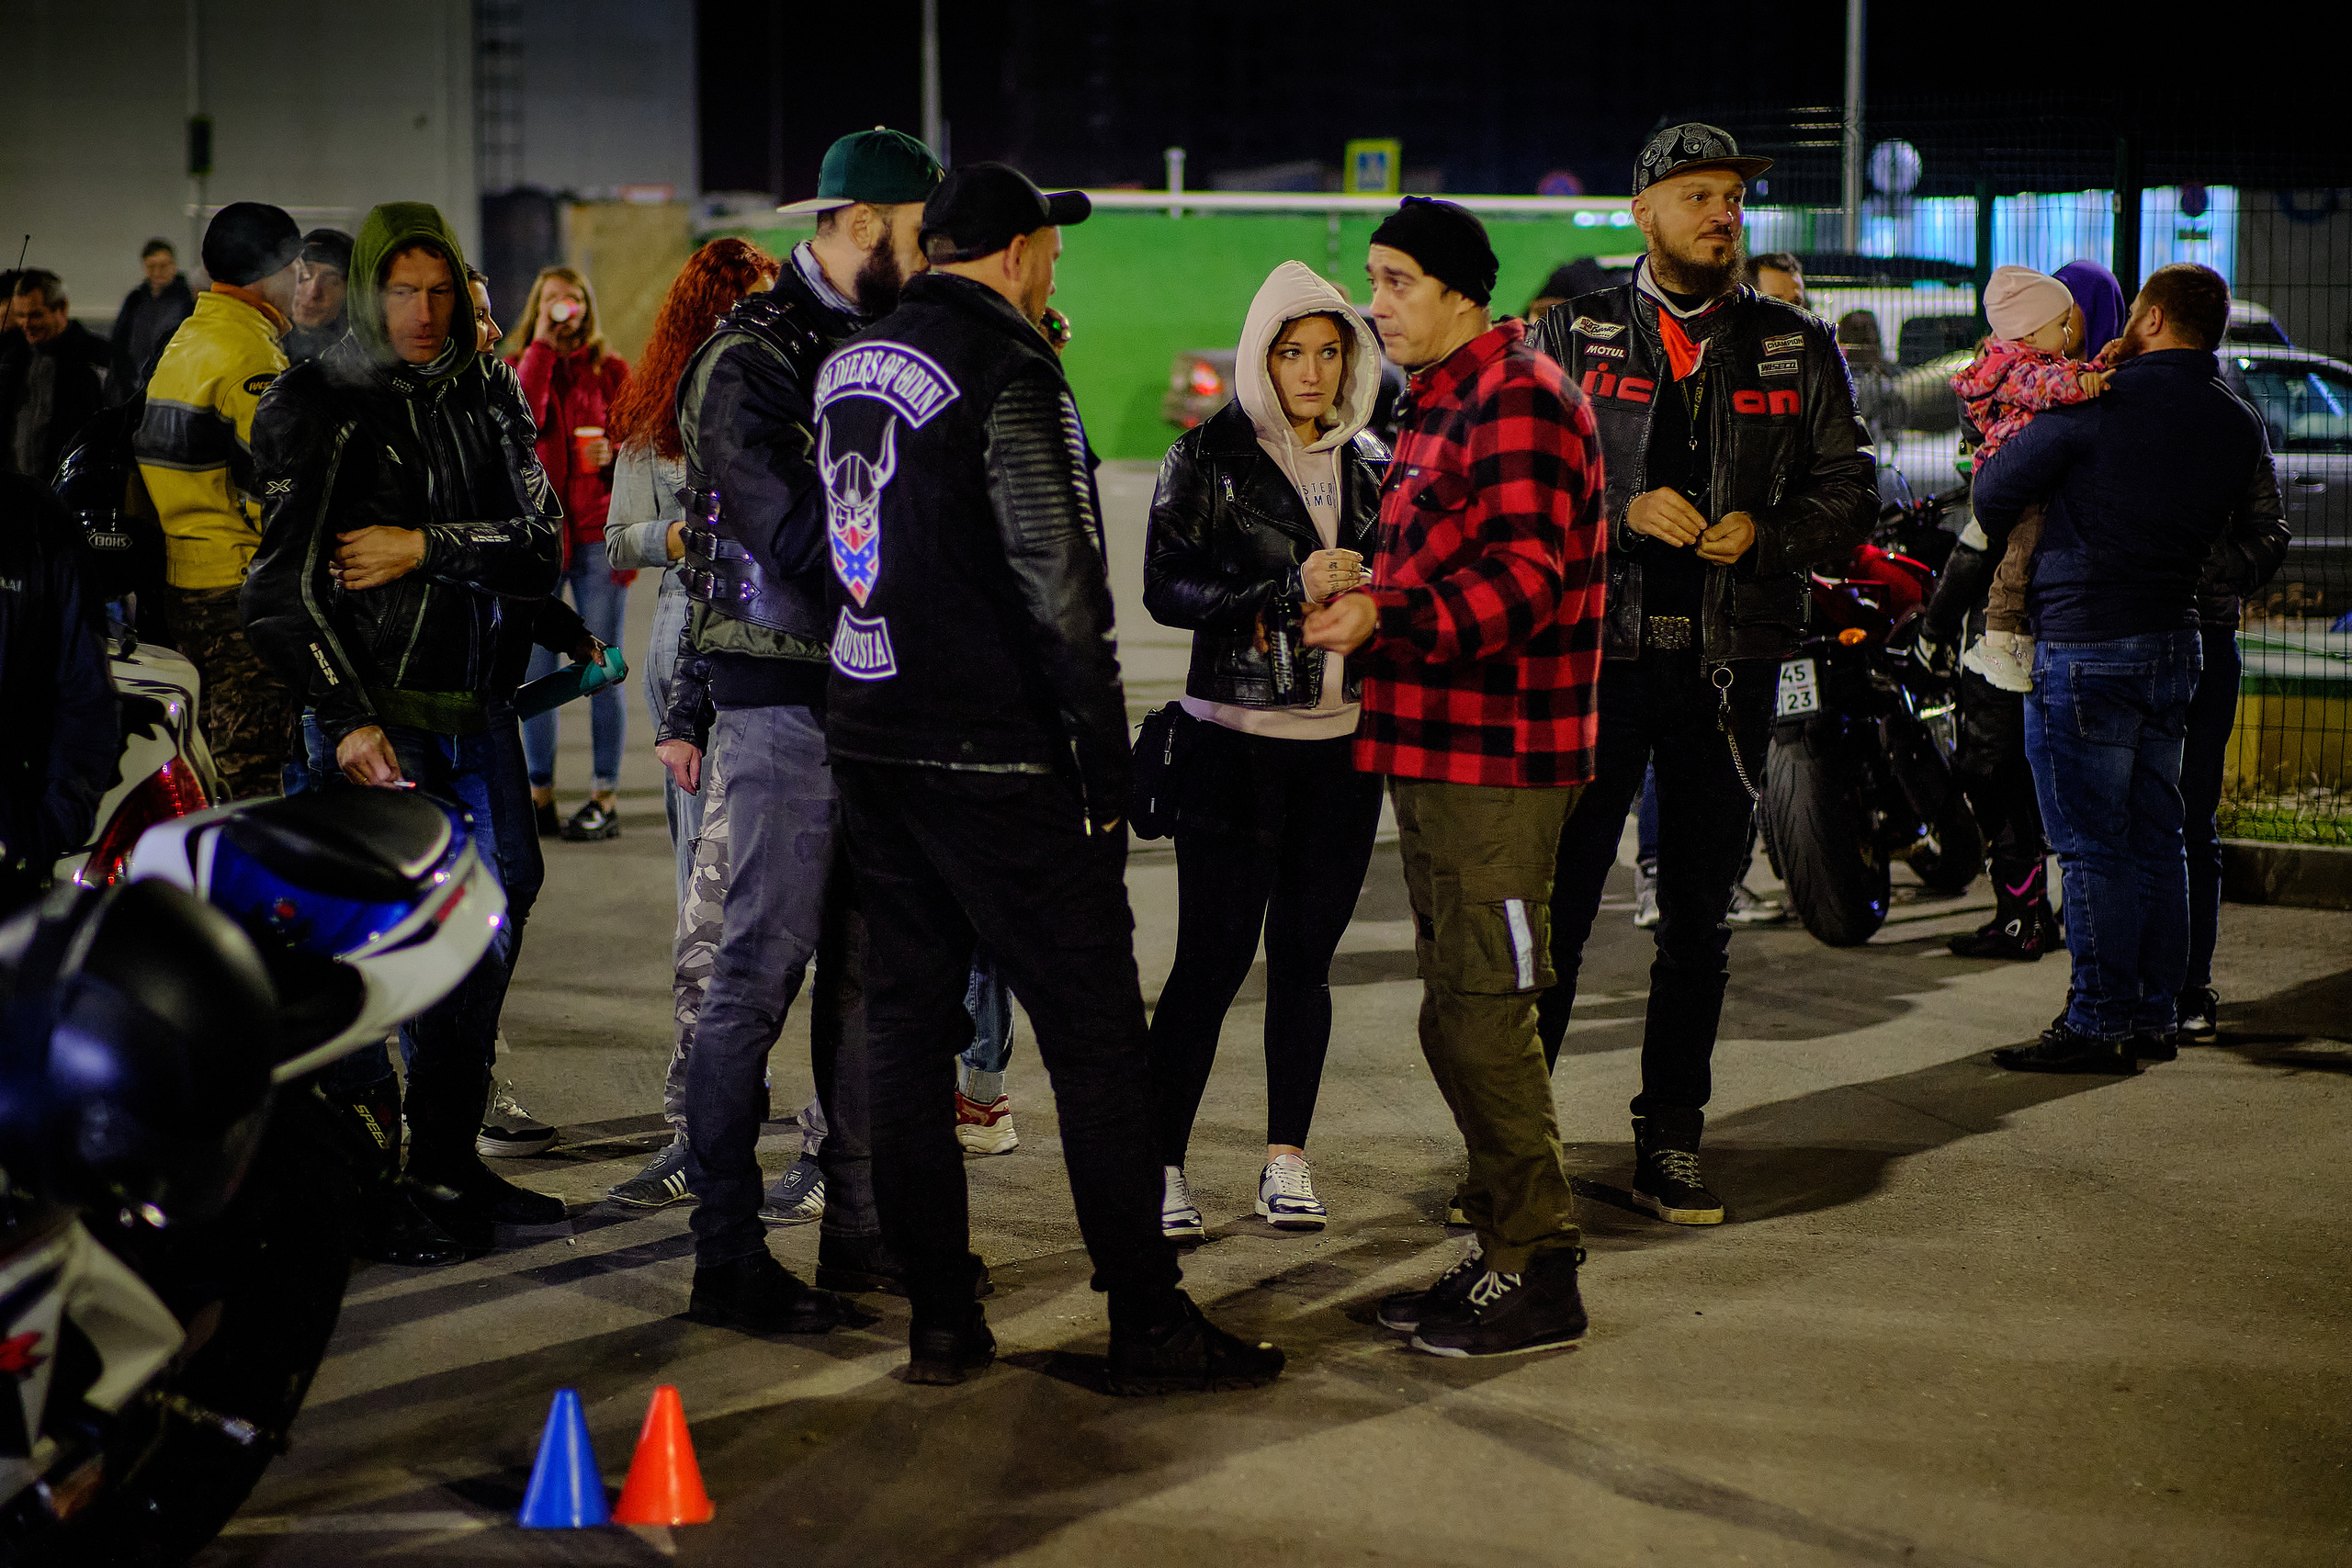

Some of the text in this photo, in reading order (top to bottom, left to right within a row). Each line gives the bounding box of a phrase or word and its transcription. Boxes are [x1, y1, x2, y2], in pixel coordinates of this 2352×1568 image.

[1586, 344, 1624, 358] MOTUL
[1767, 338, 1804, 349] CHAMPION
[876, 353, 908, 394] OF
[892, 361, 944, 416] ODIN
[94, 536, 127, 547] SHOEI
[837, 619, 888, 669] RUSSIA
[1787, 691, 1812, 710] 23
